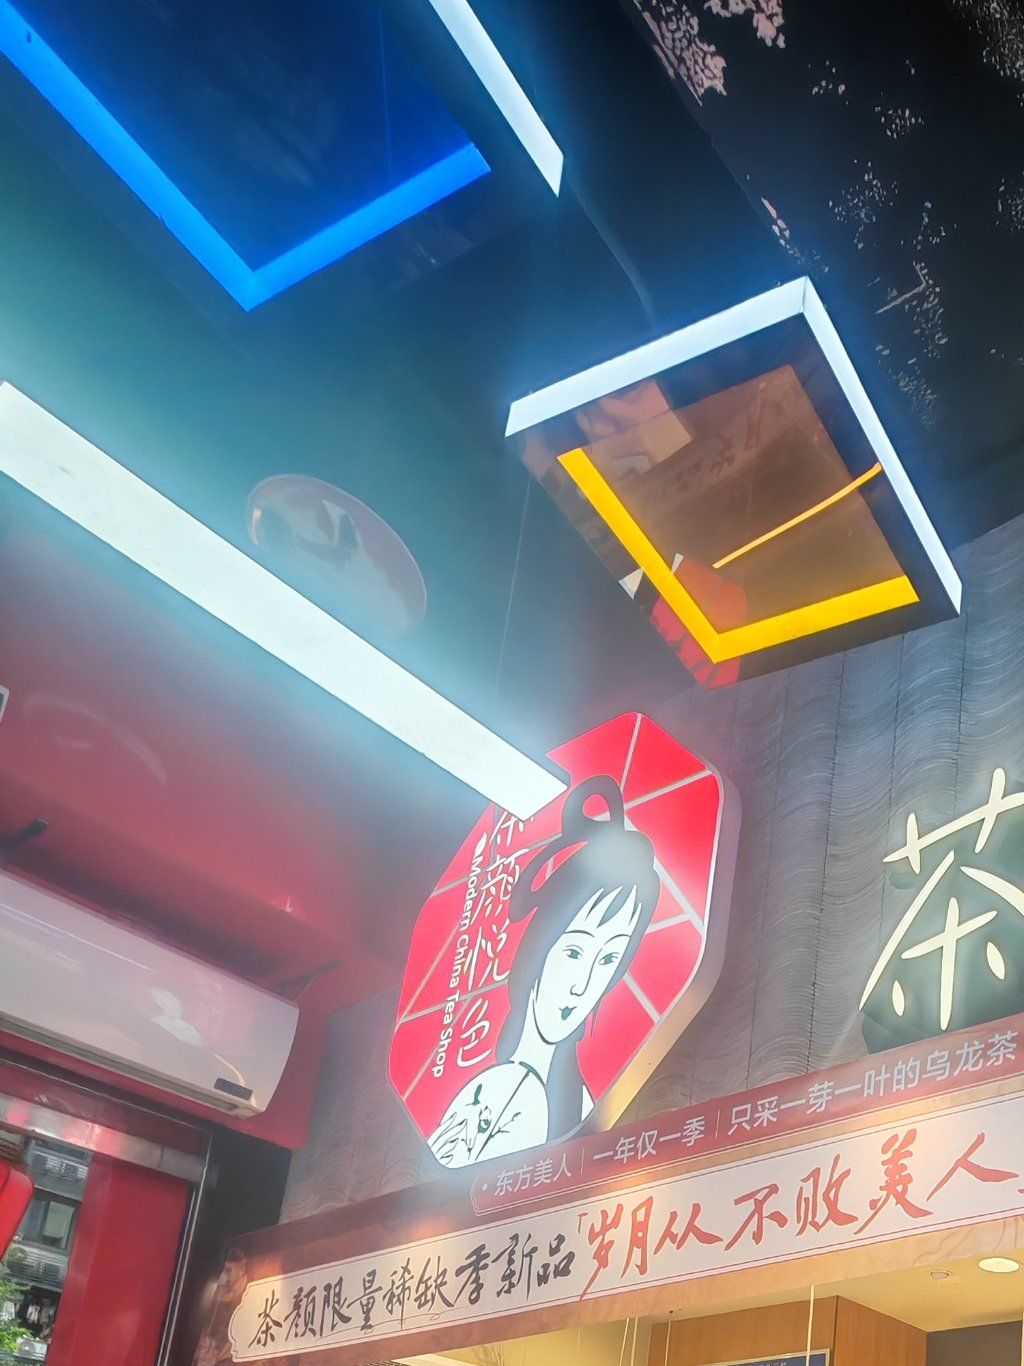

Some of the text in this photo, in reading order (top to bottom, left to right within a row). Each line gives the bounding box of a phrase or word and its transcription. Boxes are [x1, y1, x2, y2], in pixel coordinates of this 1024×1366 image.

[432, 855, 483, 1079] Modern China Tea Shop
[494, 1030, 1018, 1198] 东方美人 一年仅一季 只采一芽一叶的乌龙茶
